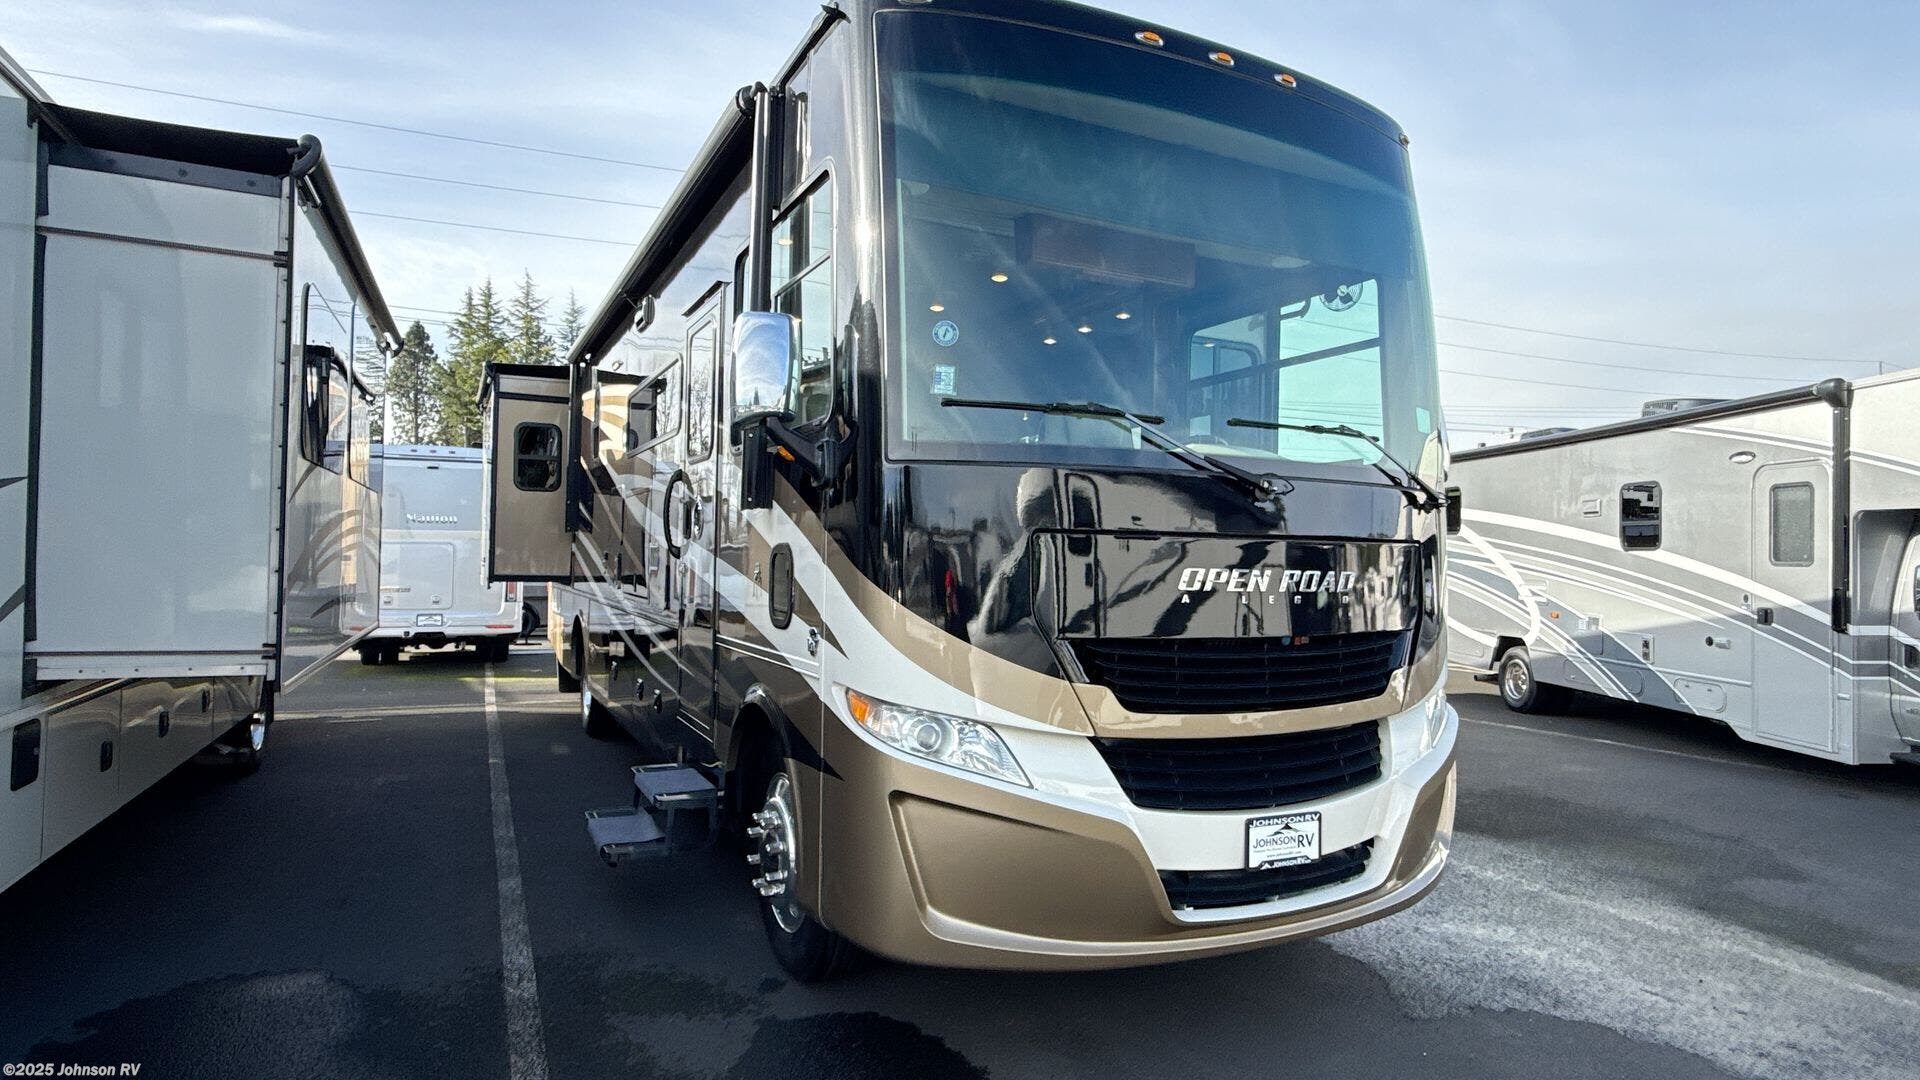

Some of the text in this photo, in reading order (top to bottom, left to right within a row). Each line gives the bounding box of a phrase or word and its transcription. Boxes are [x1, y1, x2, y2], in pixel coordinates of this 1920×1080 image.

[1177, 567, 1356, 593] OPEN ROAD
[1181, 594, 1349, 604] ALEGO
